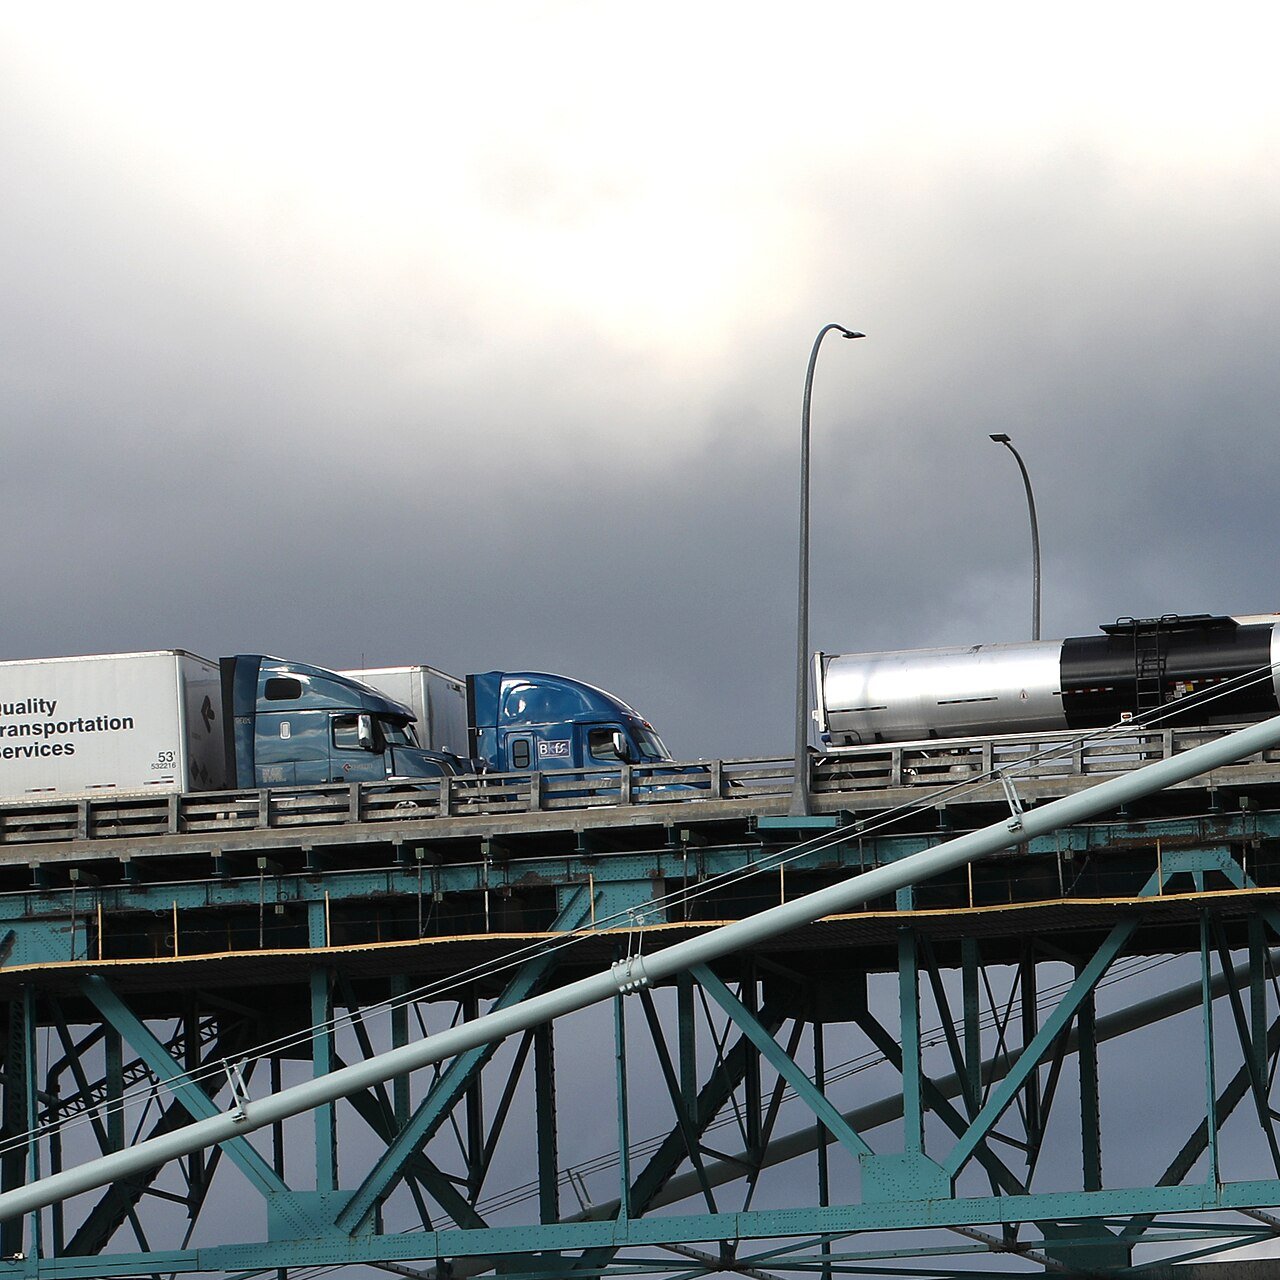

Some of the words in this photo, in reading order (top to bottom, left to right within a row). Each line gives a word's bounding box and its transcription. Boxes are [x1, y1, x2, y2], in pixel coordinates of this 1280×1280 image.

[0, 698, 57, 717] uality
[0, 715, 134, 739] ransportation
[0, 742, 75, 760] ervices
[158, 751, 176, 762] 53'
